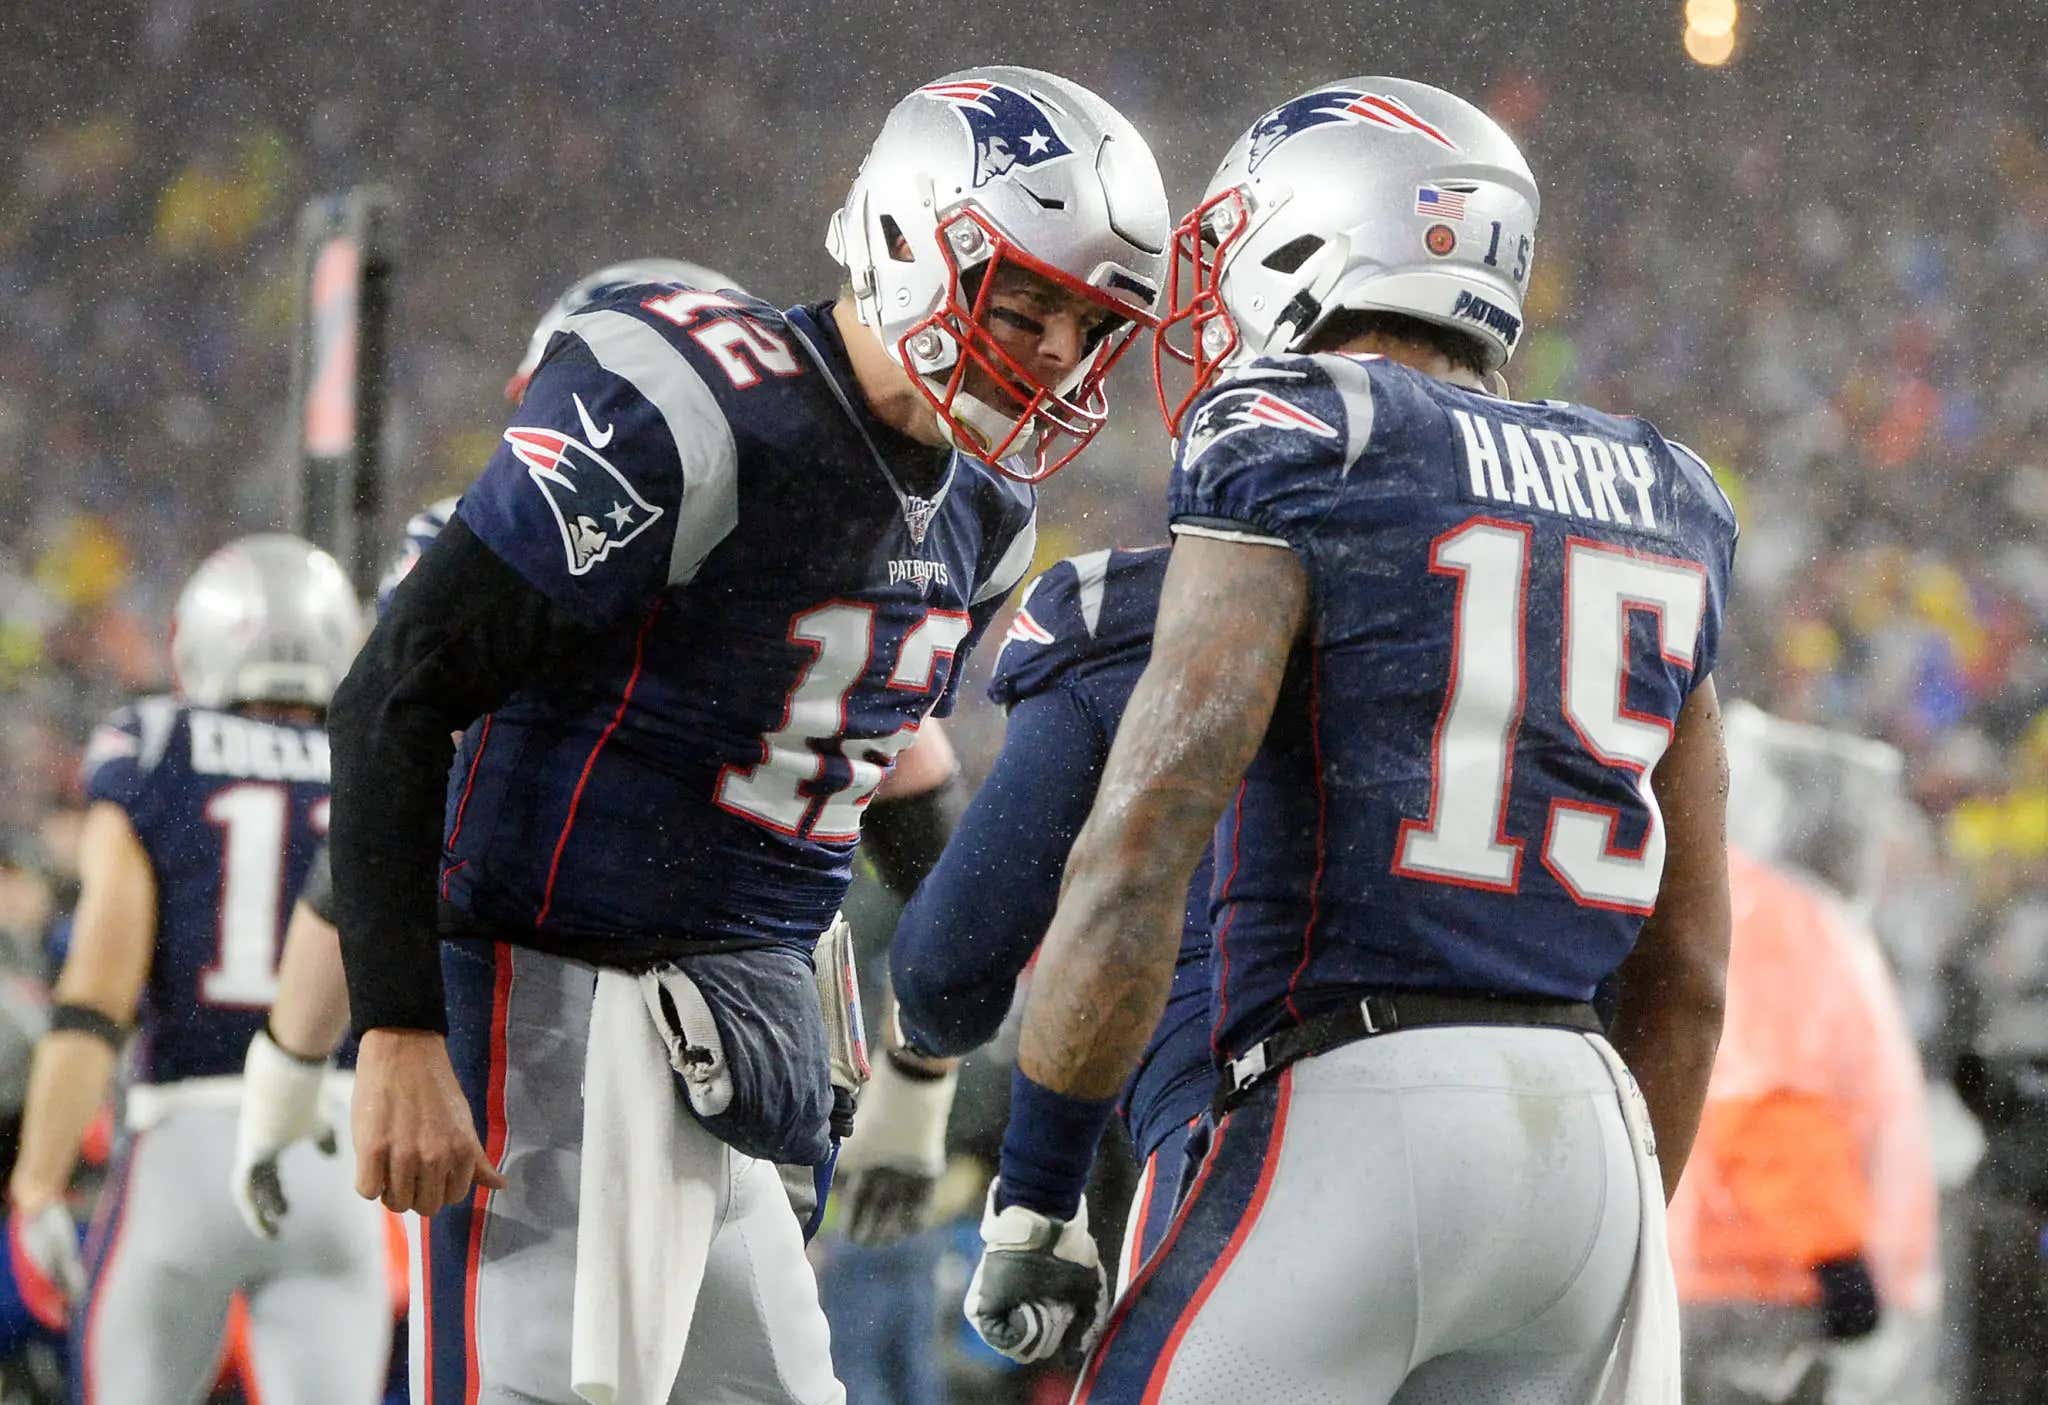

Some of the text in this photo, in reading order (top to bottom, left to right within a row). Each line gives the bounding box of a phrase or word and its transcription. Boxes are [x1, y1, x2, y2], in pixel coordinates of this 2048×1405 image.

[1483, 220, 1530, 283] 15
[640, 289, 803, 391] 12
[1453, 409, 1657, 529] HARRY
[887, 559, 948, 587] PATRIOTS
[713, 598, 972, 843] 12
[1391, 515, 1707, 917] 15
[199, 782, 331, 1012] 1
